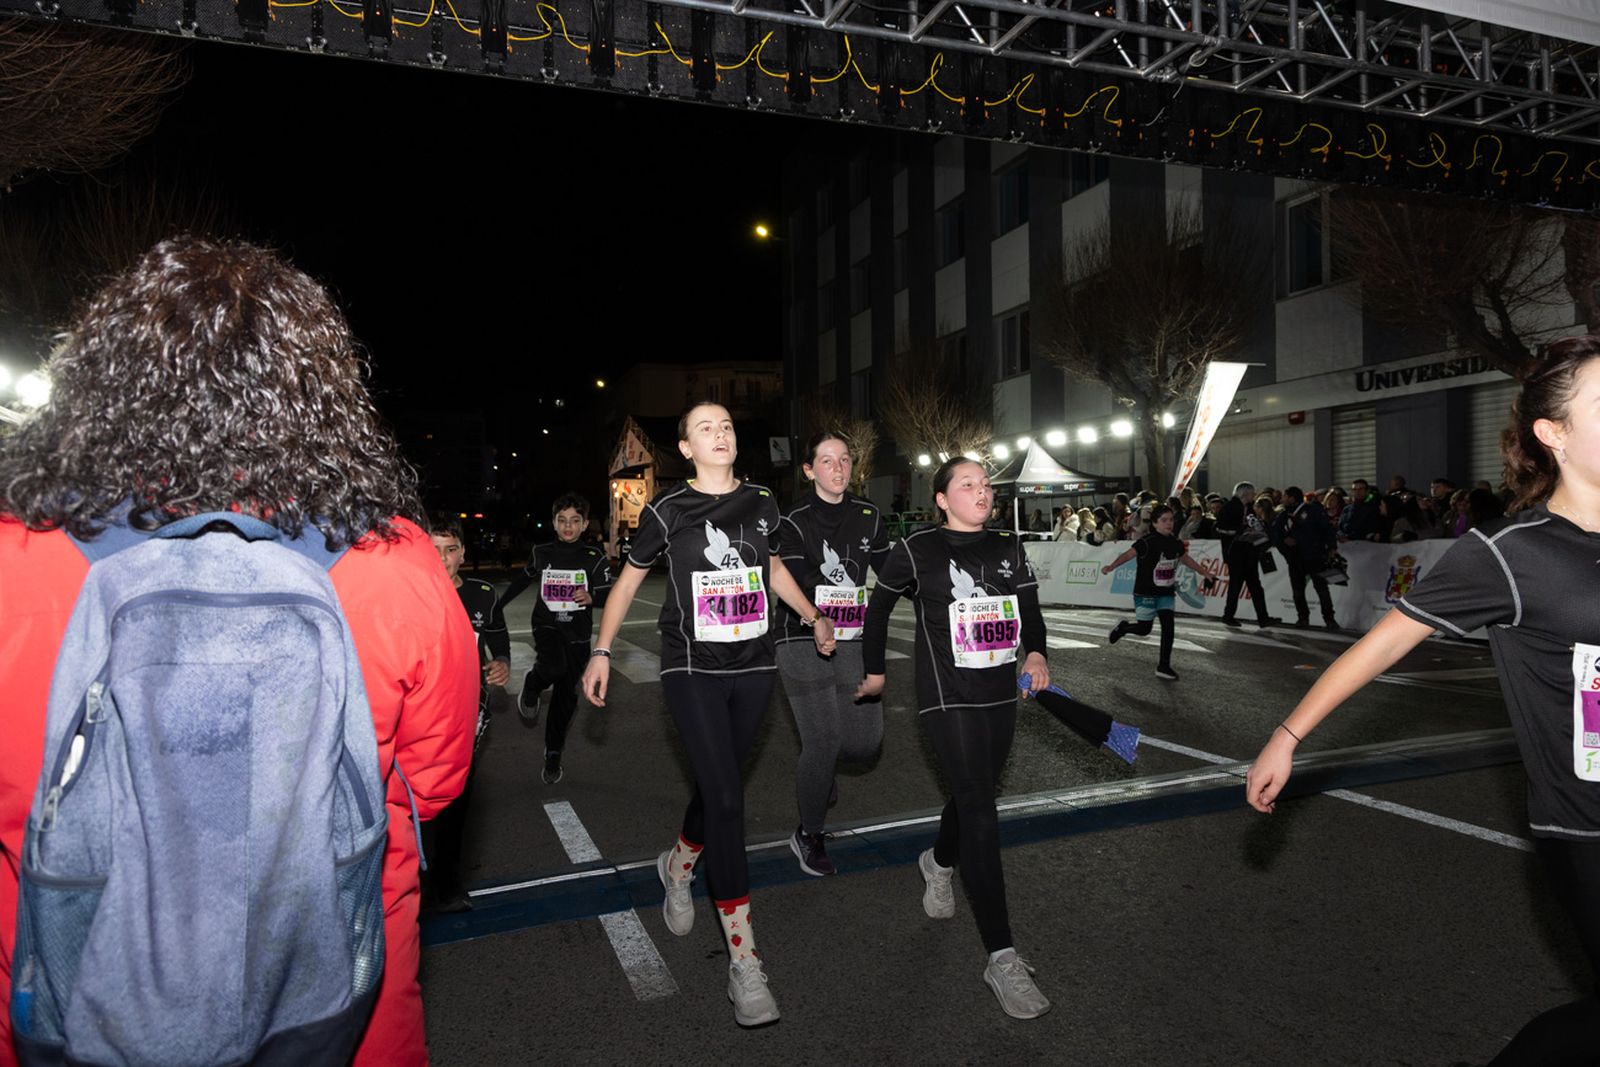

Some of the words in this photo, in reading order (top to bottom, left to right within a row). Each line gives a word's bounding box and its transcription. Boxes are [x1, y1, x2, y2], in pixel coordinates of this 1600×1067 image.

[721, 554, 739, 569] 43
[711, 577, 734, 586] NOCHE
[829, 568, 844, 582] 43
[1176, 567, 1195, 592] 43
[547, 584, 583, 598] 1562
[706, 592, 758, 618] 14182
